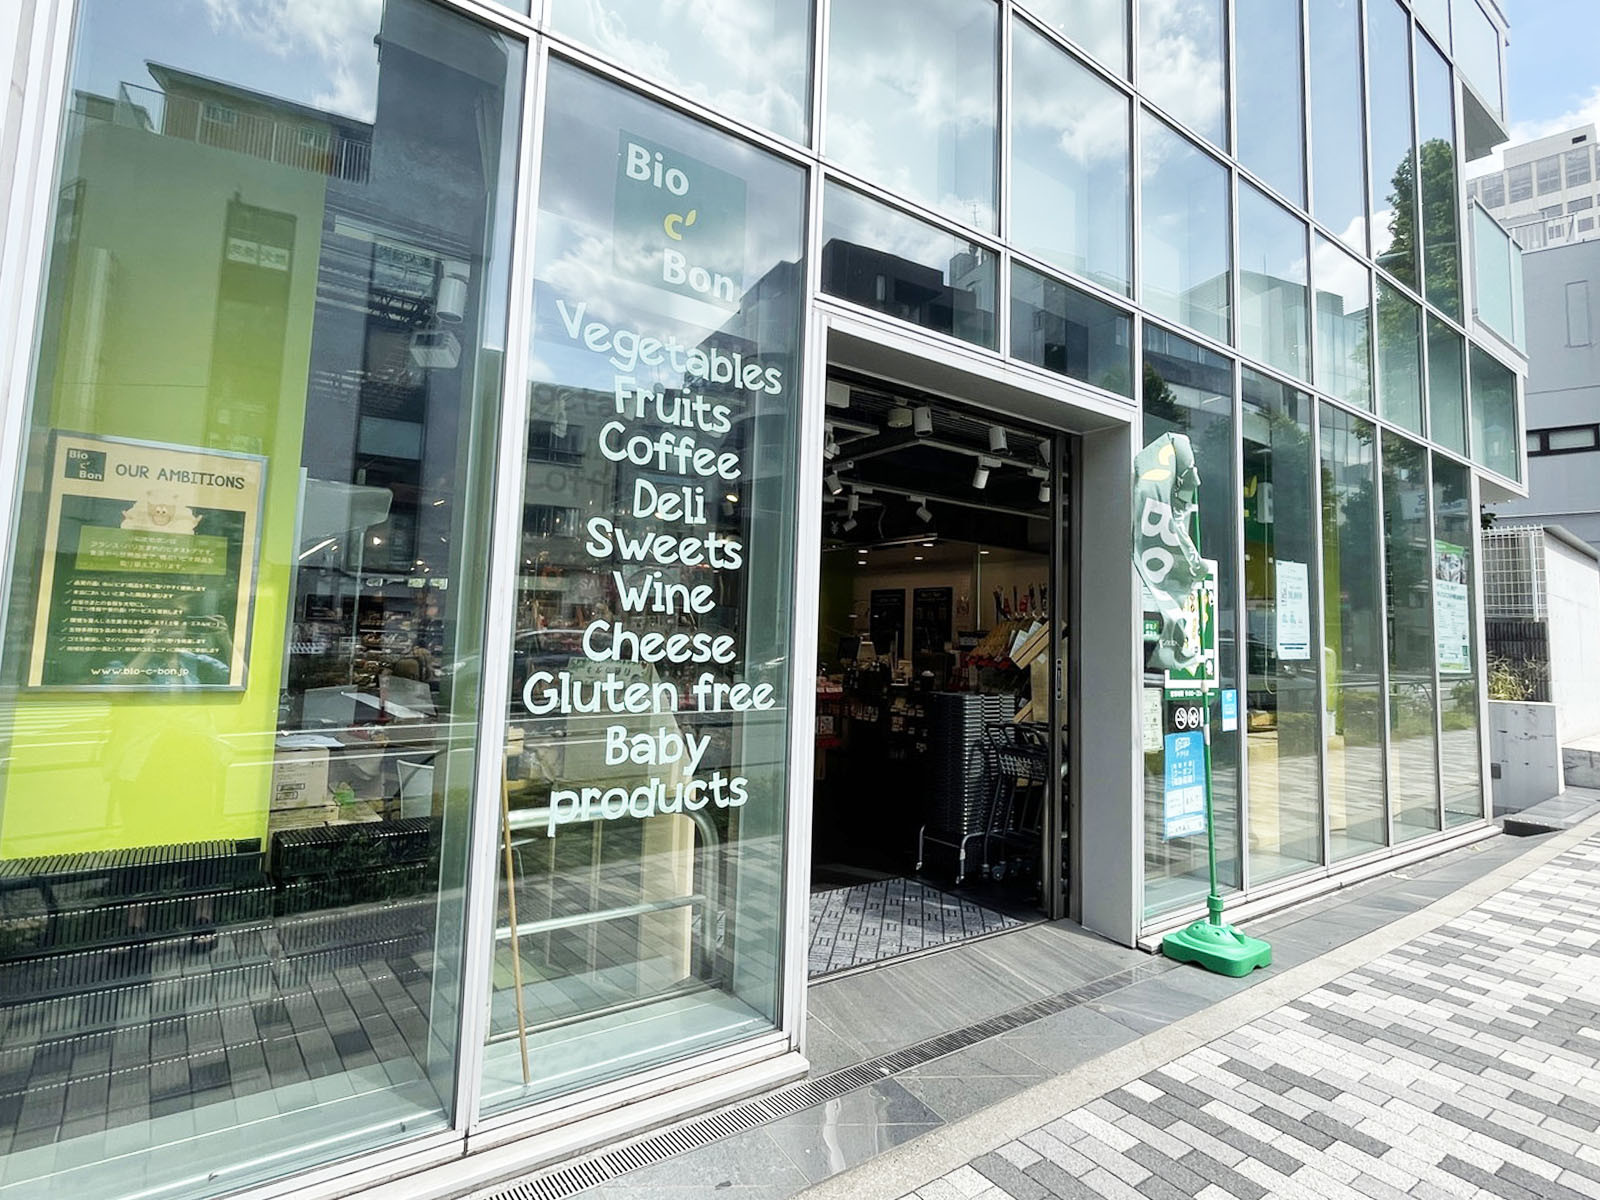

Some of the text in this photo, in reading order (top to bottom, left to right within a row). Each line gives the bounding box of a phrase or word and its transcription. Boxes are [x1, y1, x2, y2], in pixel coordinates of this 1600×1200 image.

[626, 142, 689, 196] Bio
[663, 248, 735, 302] Bon
[556, 299, 782, 395] Vegetables
[614, 375, 732, 434] Fruits
[69, 449, 89, 460] Bio
[599, 421, 741, 480] Coffee
[79, 470, 103, 481] Bon
[115, 463, 246, 490] OUR AMBITIONS
[632, 478, 706, 524] Deli
[586, 517, 743, 570] Sweets
[613, 571, 716, 615] Wine
[582, 620, 736, 664] Cheese
[90, 666, 190, 677] www.bio-c-bon.jp
[523, 671, 776, 715] Gluten free
[605, 725, 711, 776] Baby
[547, 771, 749, 838] products
